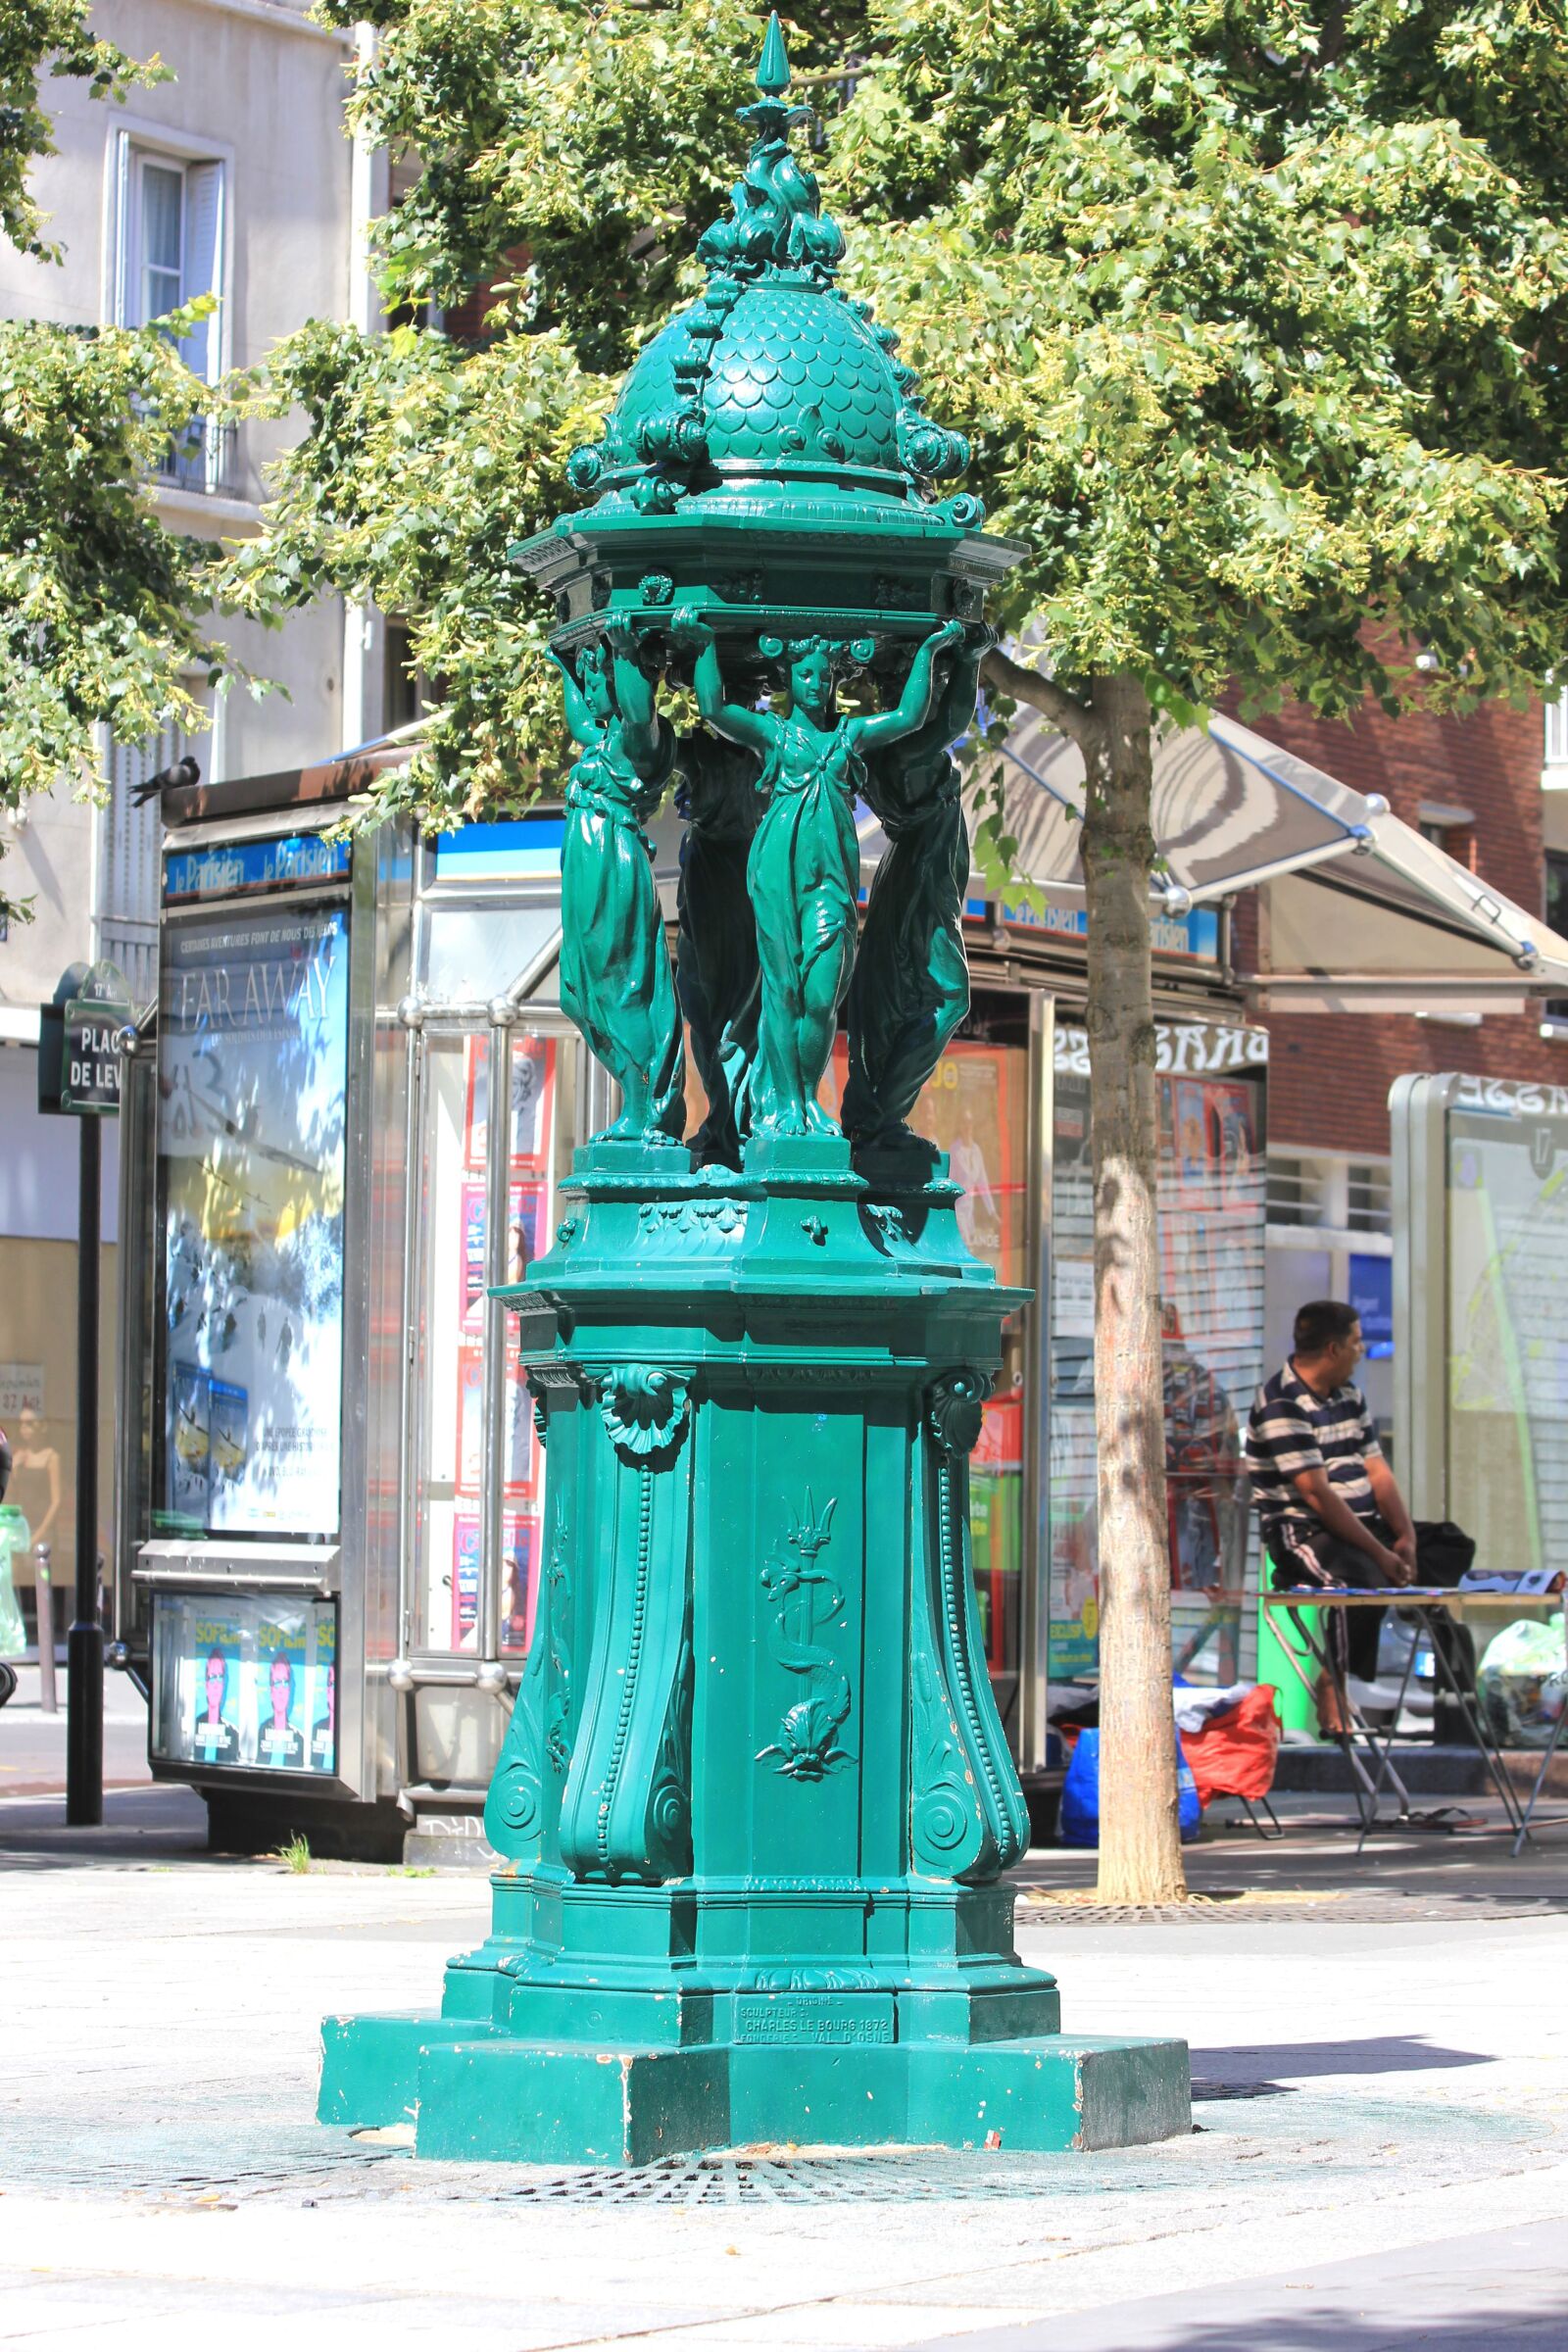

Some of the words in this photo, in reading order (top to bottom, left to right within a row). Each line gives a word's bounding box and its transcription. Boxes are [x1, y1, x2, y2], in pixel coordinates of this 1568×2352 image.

[275, 840, 339, 879] Parisien
[186, 855, 245, 892] Parisien
[211, 933, 250, 949] AVENTURES
[251, 932, 268, 945] FONT
[270, 930, 279, 943] DE
[281, 927, 302, 941] NOUS
[181, 968, 236, 1032] FAR
[242, 956, 337, 1026] AWAY
[71, 1060, 91, 1086] DE
[740, 2007, 798, 2019] SCULPTEUR
[746, 2020, 798, 2033] CHARLES
[800, 2020, 815, 2033] LE
[817, 2019, 857, 2032] BOURG
[859, 2019, 888, 2031] 1872
[810, 2033, 834, 2043] VAL
[843, 2032, 891, 2043] D'OSNE
